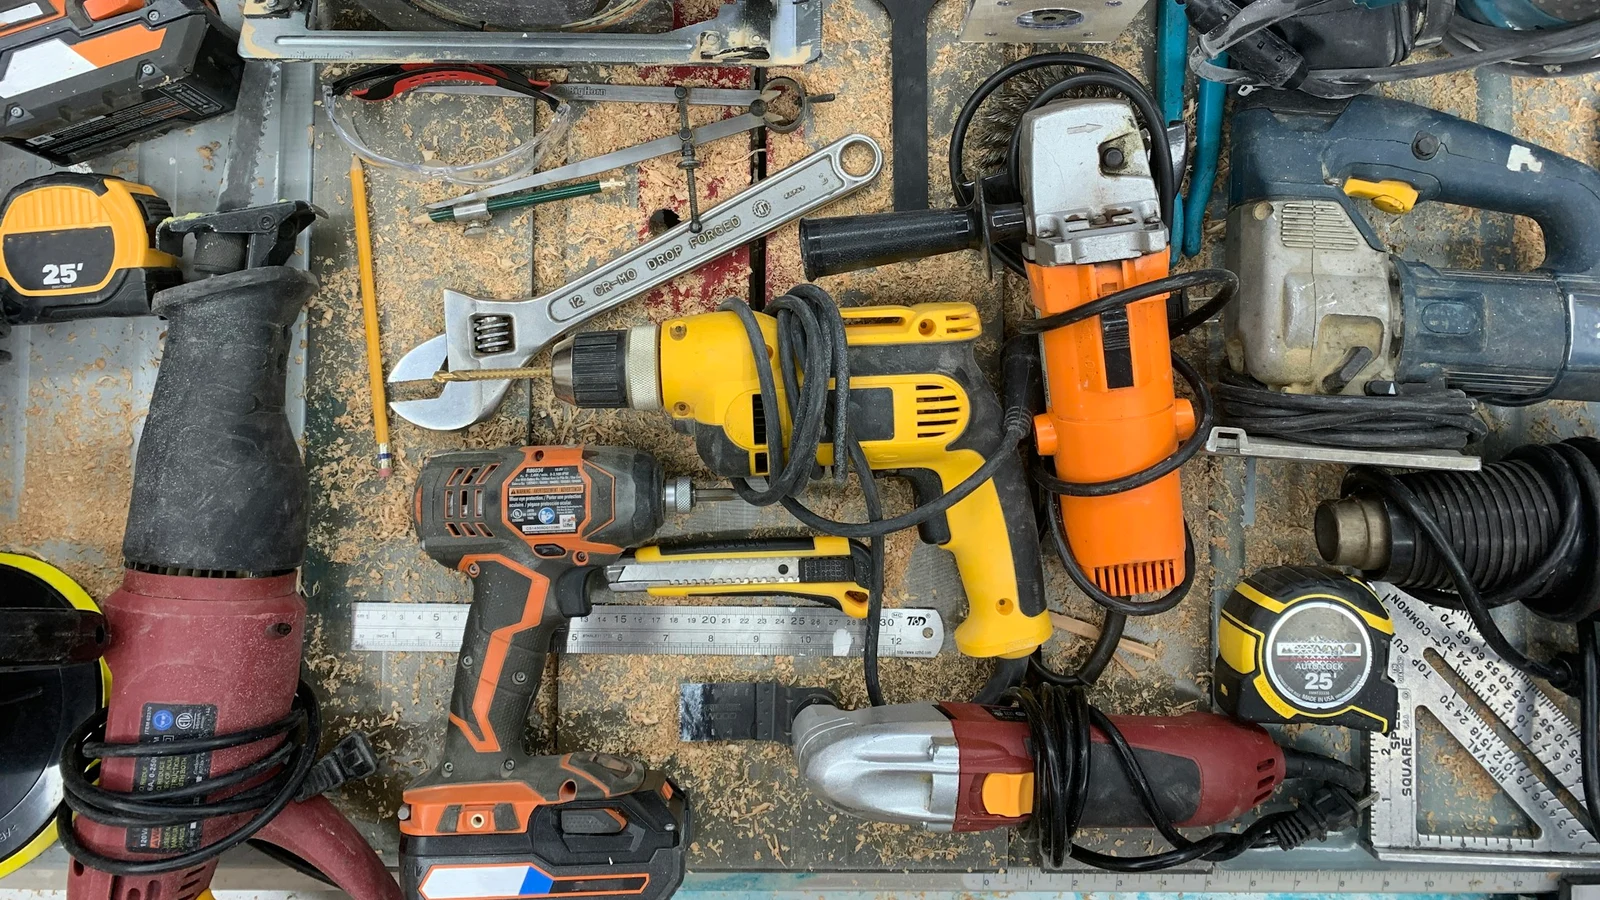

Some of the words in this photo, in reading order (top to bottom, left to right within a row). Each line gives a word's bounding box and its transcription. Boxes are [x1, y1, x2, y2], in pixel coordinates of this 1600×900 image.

[568, 86, 606, 98] BigHorn
[569, 295, 585, 309] 12
[593, 268, 637, 297] CR-MO
[646, 246, 683, 270] DROP
[689, 215, 741, 249] FORGED
[42, 263, 84, 285] 25'
[702, 616, 716, 624] 20
[791, 617, 805, 625] 25
[880, 618, 894, 626] 30
[1391, 594, 1430, 635] COMMON
[1440, 614, 1455, 629] 70
[1442, 636, 1456, 651] 30
[1456, 630, 1470, 644] 65
[1456, 650, 1471, 666] 24
[1471, 646, 1485, 660] 60
[1412, 659, 1431, 679] TOP
[1485, 661, 1499, 676] 55
[1305, 672, 1336, 690] 25'
[1475, 670, 1487, 682] 18
[1499, 675, 1513, 690] 50
[1487, 684, 1499, 696] 15
[1512, 690, 1528, 703] 45
[1301, 694, 1317, 702] MADE
[1440, 695, 1454, 710] 30
[1503, 700, 1515, 713] 12
[1524, 702, 1539, 718] 40
[1454, 710, 1468, 724] 24
[1517, 714, 1529, 727] 10
[1470, 727, 1482, 739] 18
[1539, 718, 1554, 734] 35
[1533, 731, 1542, 740] 8
[1554, 733, 1569, 749] 30
[1480, 738, 1492, 750] 15
[1468, 739, 1507, 783] HIP-VAL
[1493, 750, 1505, 764] 12
[1552, 752, 1560, 760] 6
[156, 761, 165, 785] REDUCE
[1401, 737, 1412, 796] SQUARE
[1504, 763, 1516, 775] 10
[1562, 763, 1571, 772] 5
[1516, 776, 1525, 784] 8
[1531, 792, 1540, 801] 6
[1538, 800, 1548, 810] 5
[1557, 819, 1566, 829] 3
[1567, 829, 1577, 839] 2
